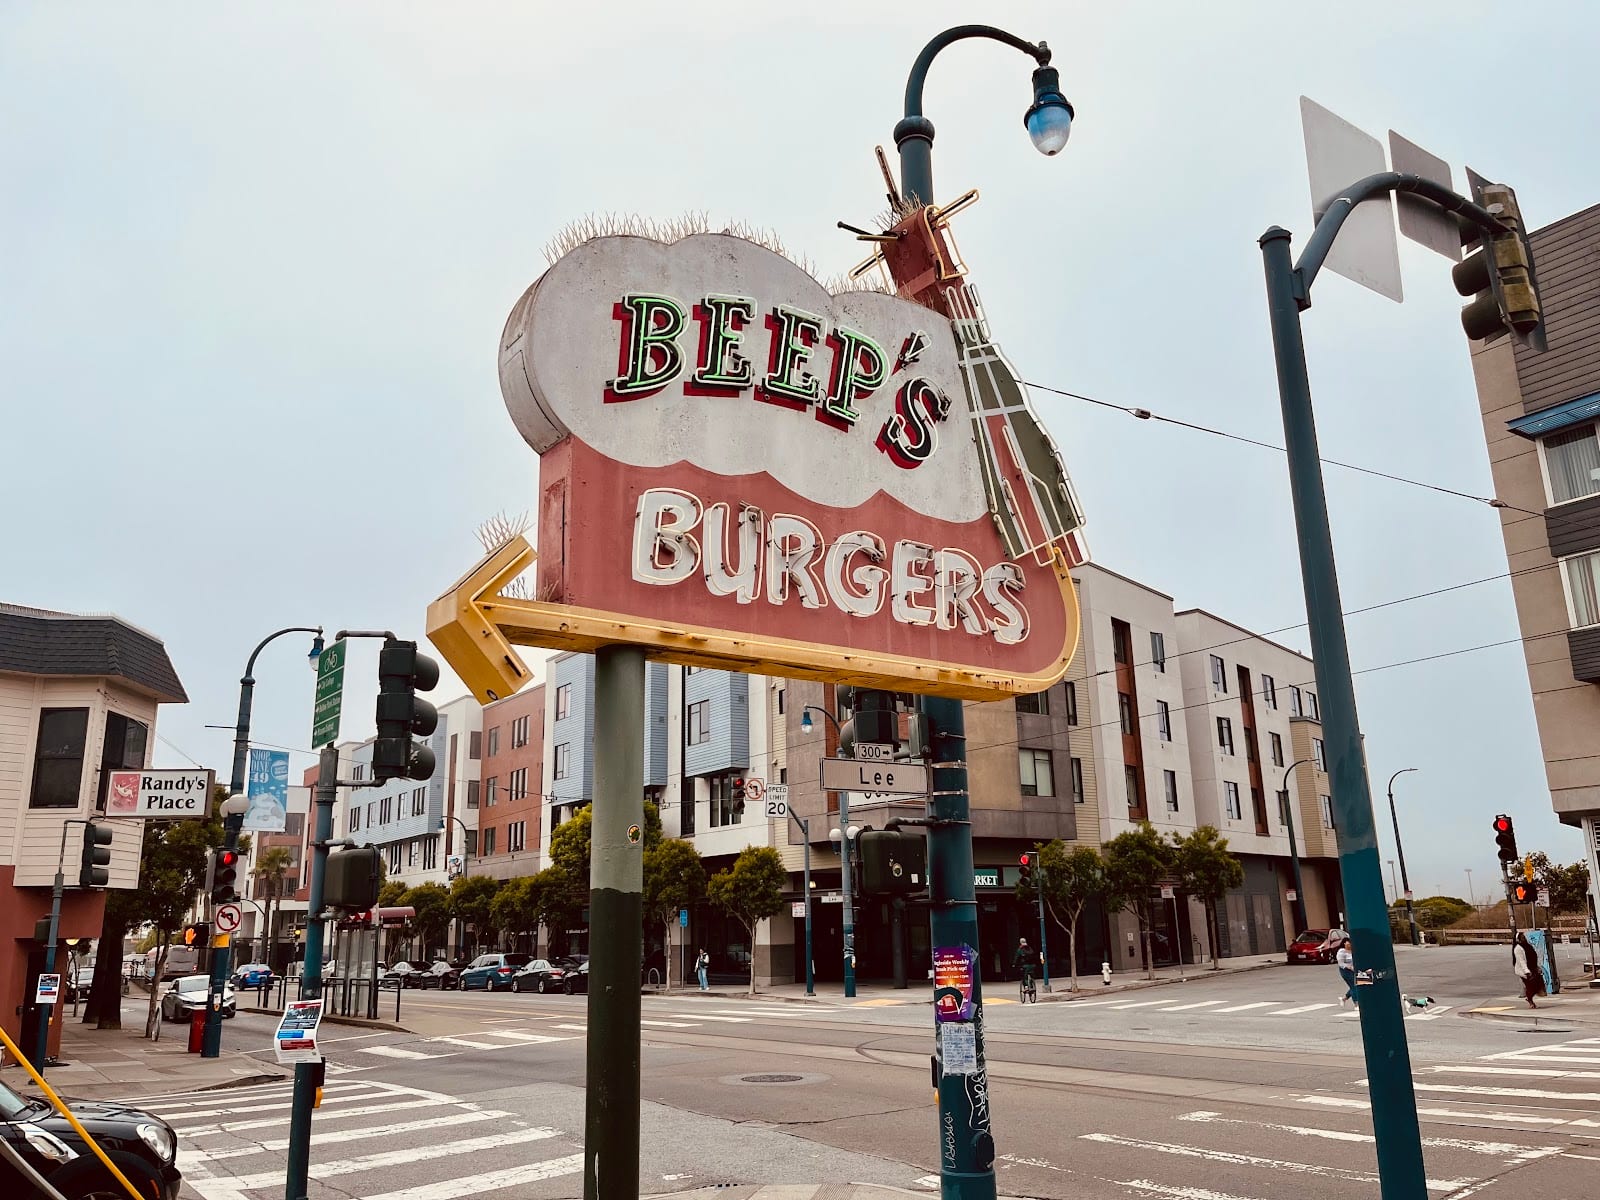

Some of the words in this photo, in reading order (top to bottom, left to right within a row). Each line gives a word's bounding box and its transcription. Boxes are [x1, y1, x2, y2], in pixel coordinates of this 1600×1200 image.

[603, 292, 952, 470] BEEP'S
[631, 487, 1030, 645] BURGERS
[861, 746, 881, 758] 300
[141, 776, 205, 794] Randy's
[859, 766, 895, 786] Lee
[146, 795, 196, 810] Place
[768, 802, 786, 815] 20
